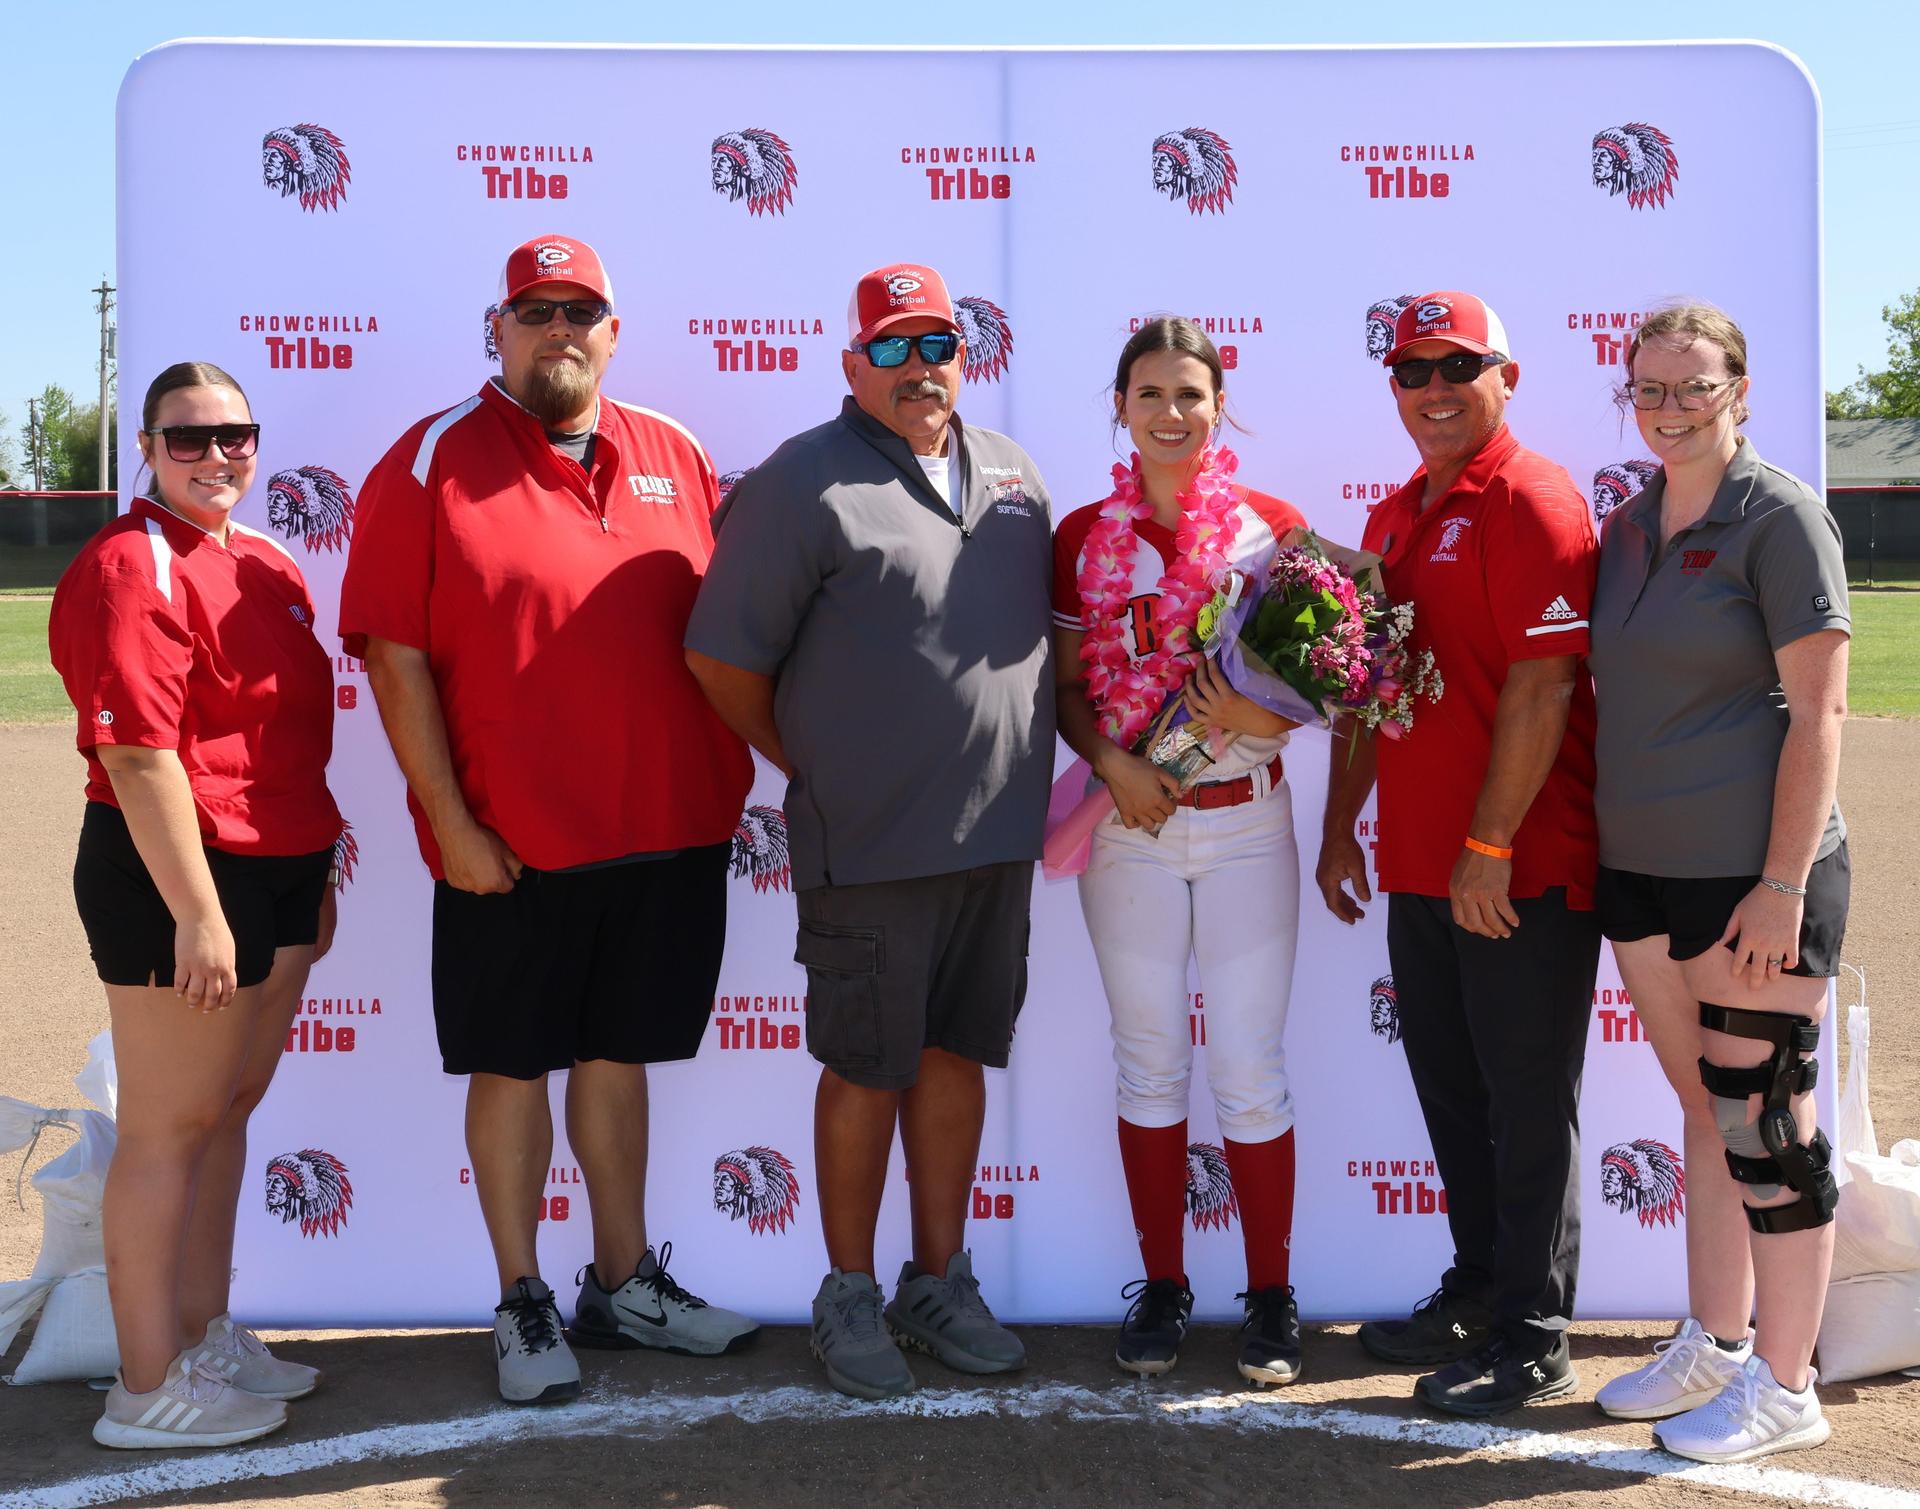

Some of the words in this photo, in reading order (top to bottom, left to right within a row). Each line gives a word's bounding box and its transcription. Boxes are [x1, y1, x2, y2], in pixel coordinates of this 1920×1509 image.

[457, 145, 593, 162] CHOWCHILLA
[902, 147, 1035, 163] CHOWCHILLA
[1341, 144, 1475, 162] CHOWCHILLA
[537, 267, 573, 276] Softball
[889, 296, 926, 307] Softball
[240, 315, 378, 332] CHOWCHILLA
[689, 318, 823, 336] CHOWCHILLA
[1129, 318, 1263, 333] CHILLA
[1415, 321, 1451, 333] Softball
[628, 475, 677, 496] TRIBE
[996, 505, 1031, 516] SOFTBALL
[1541, 610, 1578, 621] adidas
[296, 999, 382, 1014] CHILLA
[284, 1020, 355, 1052] ribe
[1348, 1161, 1434, 1176] CHOWCH
